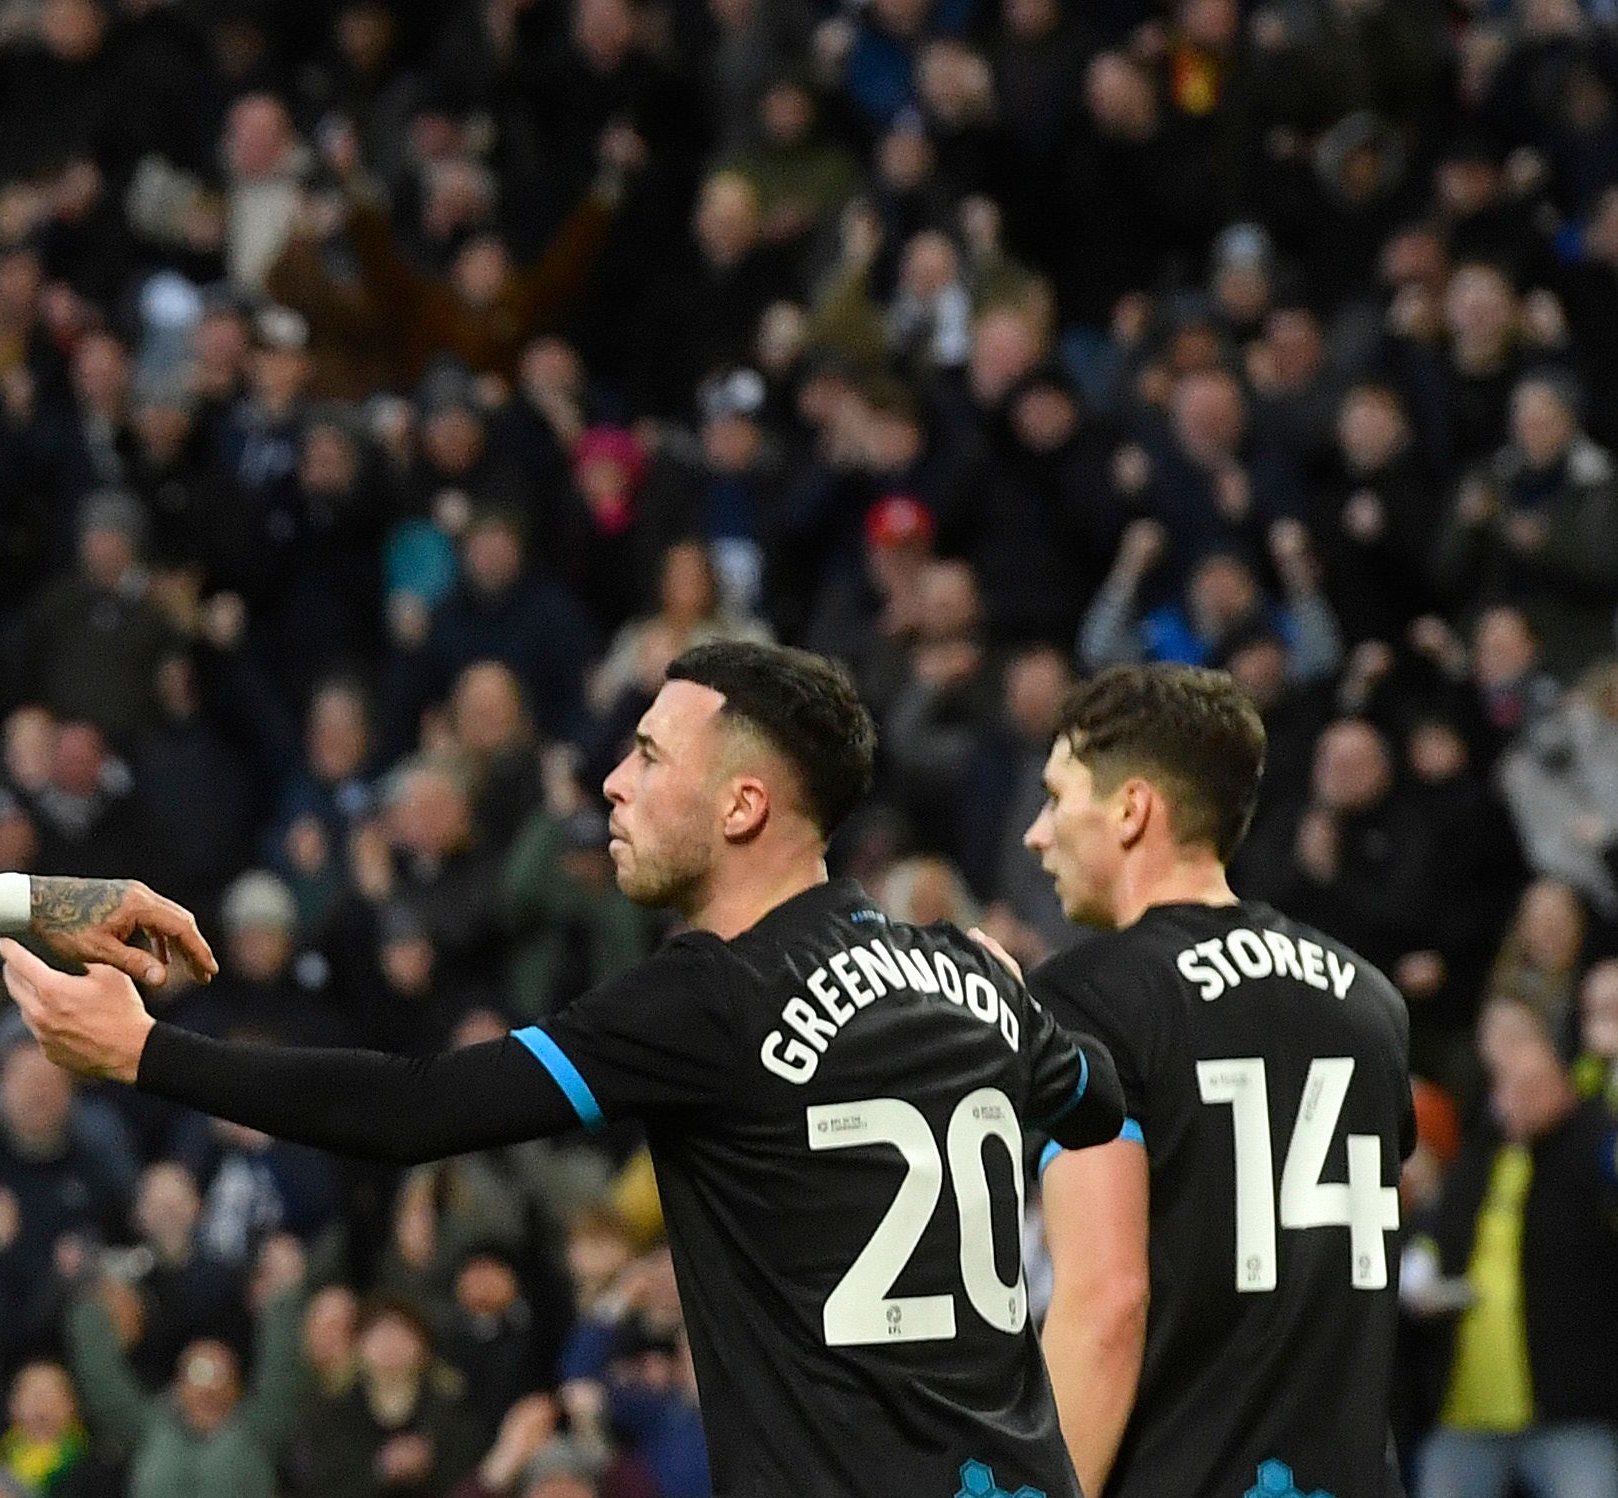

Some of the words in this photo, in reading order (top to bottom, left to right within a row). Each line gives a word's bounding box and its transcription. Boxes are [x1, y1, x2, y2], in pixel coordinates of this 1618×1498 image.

[761, 939, 1020, 1085] GREENWOOD
[1177, 928, 1356, 1001] STOREY
[807, 1087, 1027, 1346] 20
[1196, 1057, 1400, 1293] 14
